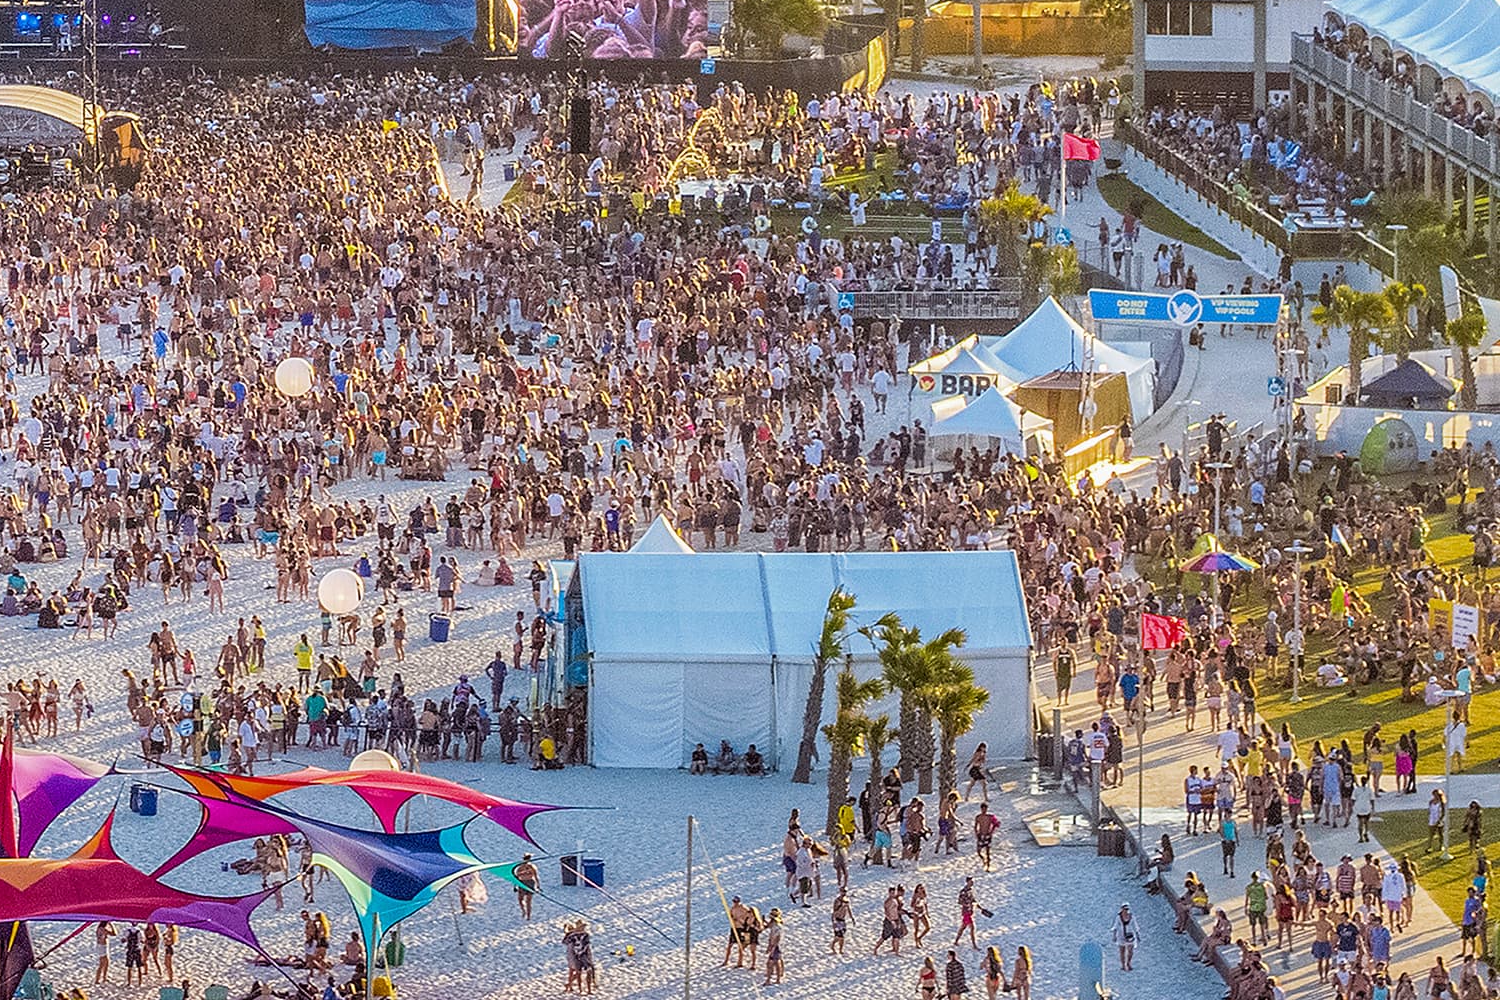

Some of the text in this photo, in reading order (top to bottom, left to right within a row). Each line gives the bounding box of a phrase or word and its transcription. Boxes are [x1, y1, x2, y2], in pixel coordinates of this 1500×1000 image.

[1116, 300, 1149, 308] DO NOT
[1119, 307, 1146, 315] ENTER
[941, 375, 991, 396] BAR
